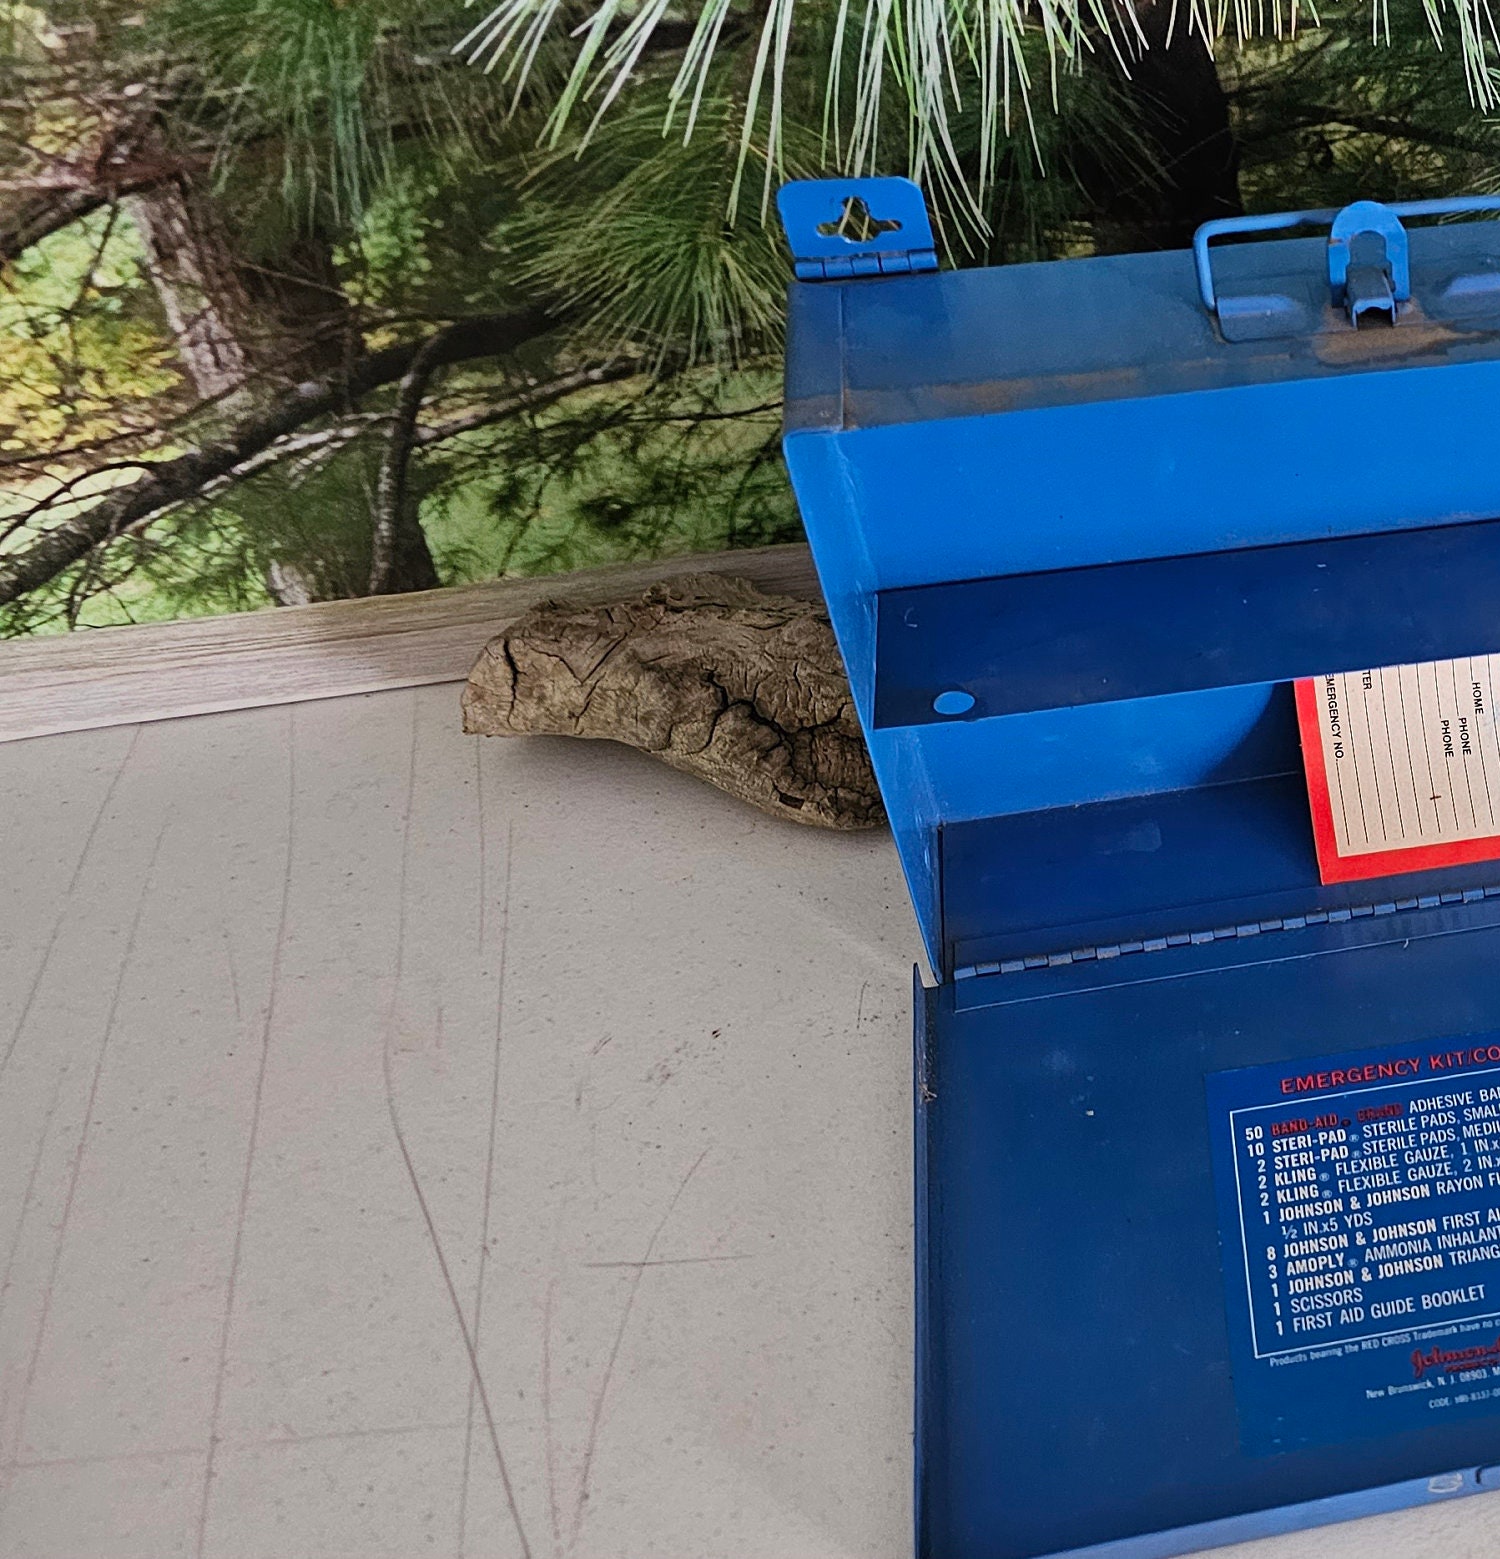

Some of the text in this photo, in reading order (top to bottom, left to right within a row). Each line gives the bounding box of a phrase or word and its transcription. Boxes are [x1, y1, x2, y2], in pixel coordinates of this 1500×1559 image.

[1472, 682, 1484, 715] HOME
[1441, 719, 1454, 758] PHONE
[1458, 717, 1471, 755] PHONE
[1280, 1057, 1422, 1094] EMERGENCY
[1245, 1125, 1264, 1141] 50
[1409, 1091, 1474, 1114] ADHESIVE
[1247, 1142, 1264, 1157] 10
[1272, 1128, 1347, 1154] STERI-PAD
[1362, 1117, 1418, 1139] STERILE
[1421, 1111, 1460, 1129] PADS,
[1257, 1159, 1266, 1173] 2
[1274, 1145, 1349, 1170] STERI-PAD
[1362, 1134, 1418, 1156] STERILE
[1420, 1129, 1460, 1146] PADS,
[1258, 1176, 1267, 1189] 2
[1274, 1167, 1317, 1187] KLING
[1335, 1153, 1399, 1176] FLEXIBLE
[1404, 1145, 1454, 1165] GAUZE,
[1460, 1142, 1468, 1156] 1
[1260, 1192, 1269, 1206] 2
[1276, 1184, 1319, 1204] KLING
[1338, 1170, 1402, 1194] FLEXIBLE
[1407, 1162, 1457, 1182] GAUZE,
[1463, 1159, 1472, 1173] 2
[1263, 1210, 1271, 1225] 1
[1278, 1198, 1344, 1223] JOHNSON
[1350, 1196, 1361, 1210] &
[1366, 1183, 1431, 1208] JOHNSON
[1436, 1174, 1484, 1196] RAYON
[1266, 1246, 1277, 1261] 8
[1283, 1234, 1349, 1259] JOHNSON
[1355, 1231, 1367, 1246] &
[1372, 1218, 1437, 1243] JOHNSON
[1443, 1210, 1481, 1231] FIRST
[1343, 1211, 1373, 1229] YDS
[1268, 1264, 1278, 1279] 3
[1286, 1252, 1345, 1277] AMOPLY
[1364, 1238, 1432, 1263] AMMONIA
[1271, 1283, 1279, 1298] 1
[1288, 1269, 1355, 1295] JOHNSON
[1361, 1267, 1373, 1282] &
[1378, 1254, 1444, 1279] JOHNSON
[1273, 1287, 1364, 1316] 1 SCISSORS
[1275, 1284, 1485, 1336] 1 FIRST AID GUIDE BOOKLET
[1269, 1353, 1307, 1368] Products
[1309, 1346, 1343, 1362] bearing
[1345, 1342, 1360, 1353] the
[1361, 1338, 1380, 1351] RED
[1382, 1332, 1411, 1347] CROSS
[1413, 1325, 1458, 1341] Trademark
[1460, 1322, 1480, 1333] have
[1482, 1320, 1493, 1329] no
[1366, 1388, 1385, 1399] New
